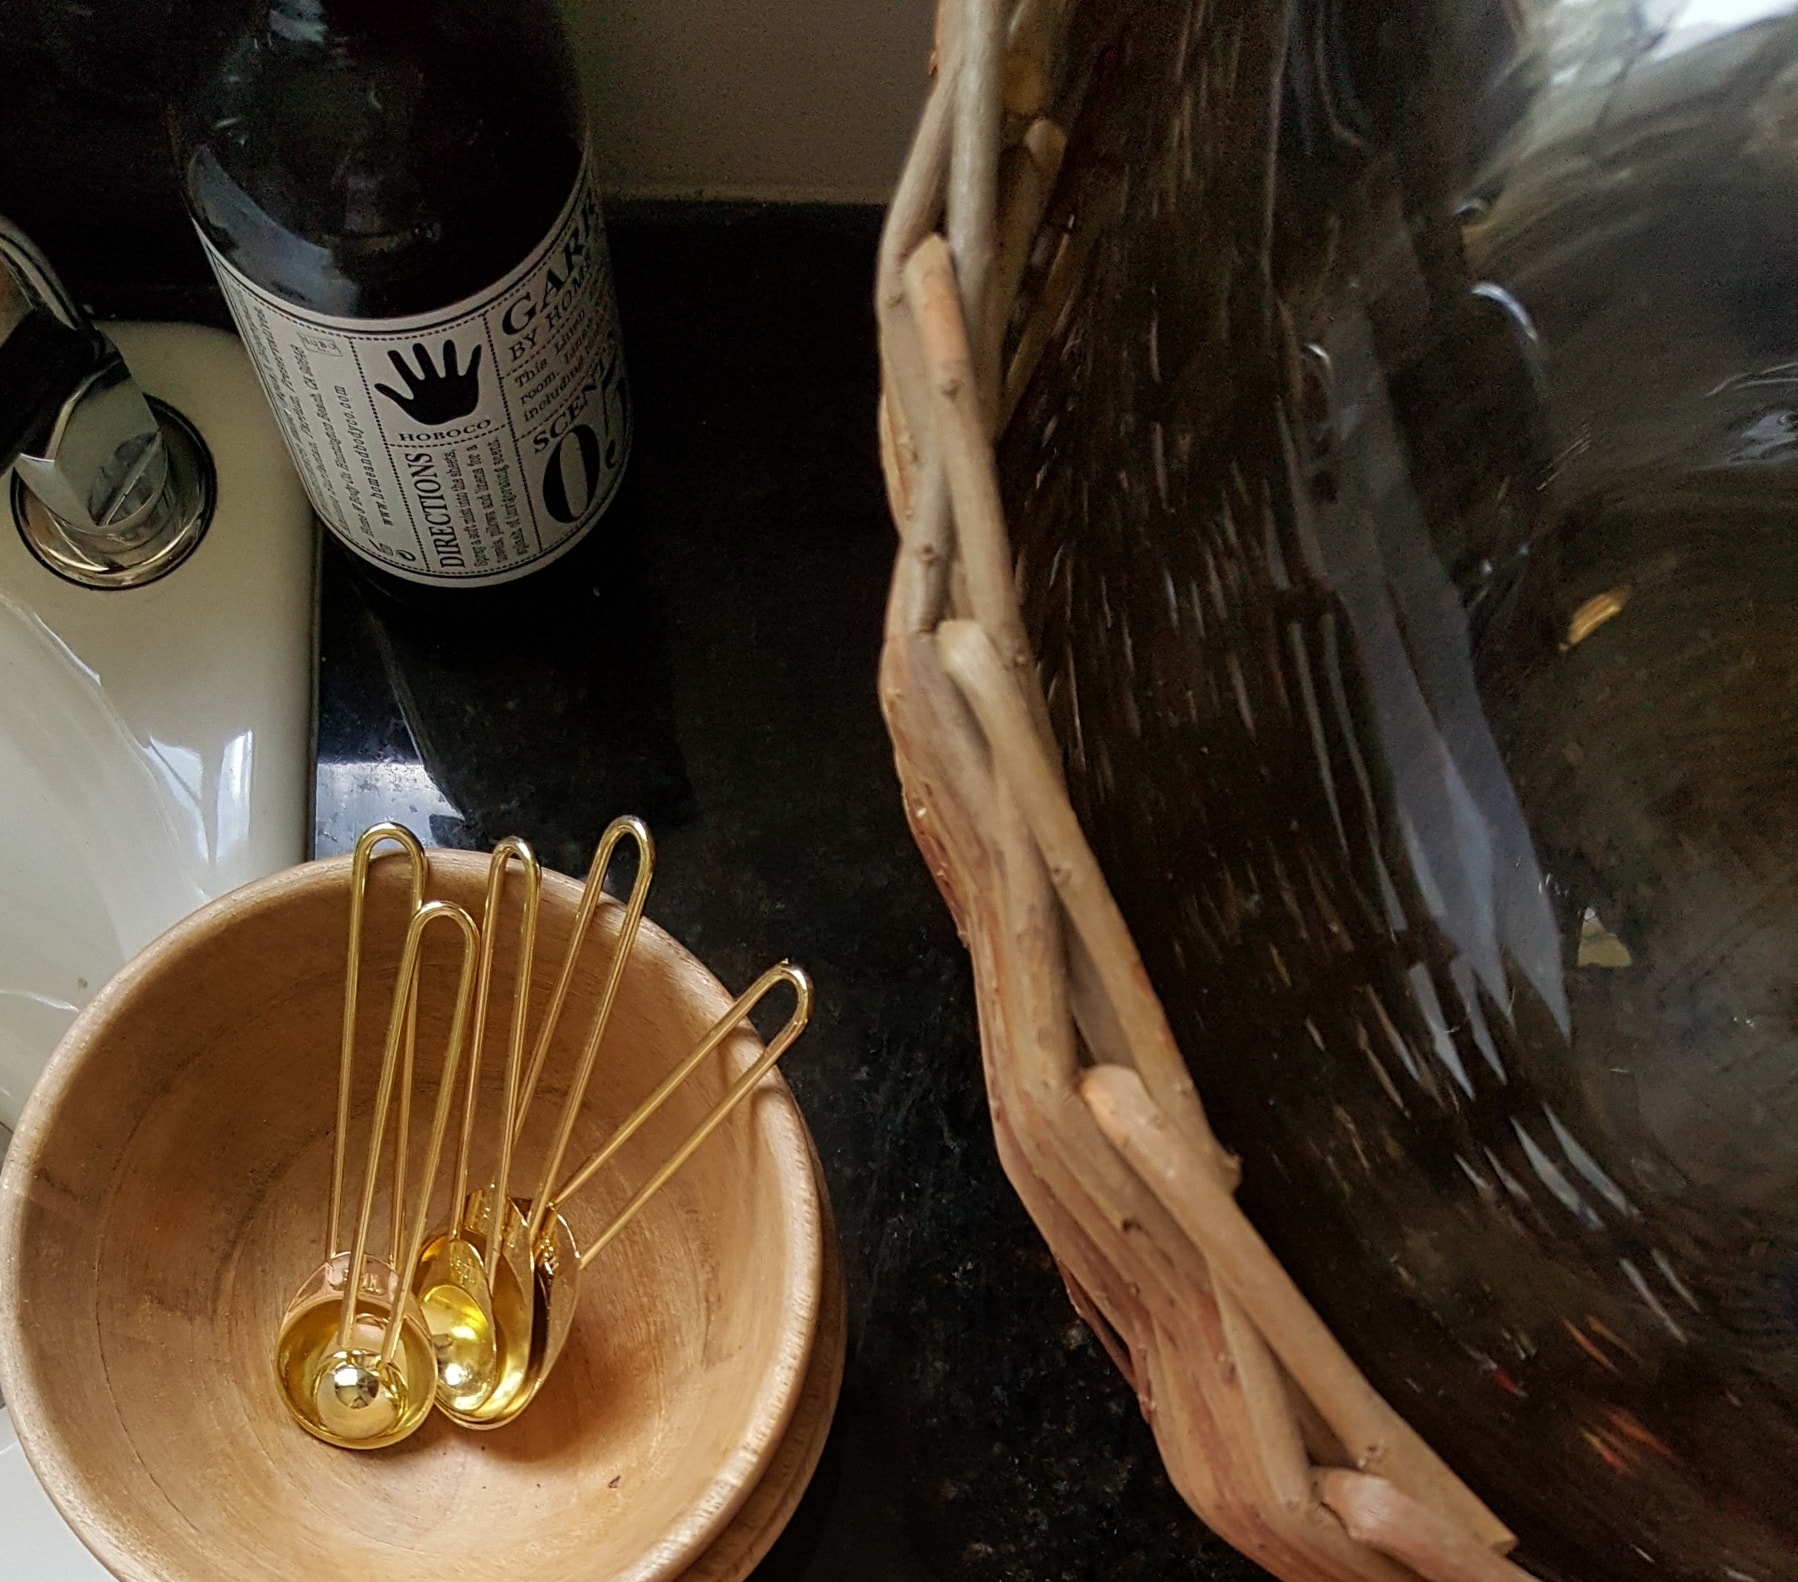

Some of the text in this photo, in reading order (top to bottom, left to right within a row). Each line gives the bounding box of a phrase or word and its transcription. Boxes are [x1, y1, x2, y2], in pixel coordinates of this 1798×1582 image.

[508, 325, 539, 362] BY
[514, 358, 548, 387] This
[520, 372, 560, 405] room.
[399, 419, 492, 442] HOBOCO
[334, 384, 393, 526] www.homeandbodyco.com
[468, 454, 482, 466] for
[451, 478, 465, 491] the
[405, 452, 466, 568] DIRECTIONS
[477, 493, 494, 509] and
[506, 518, 520, 528] of
